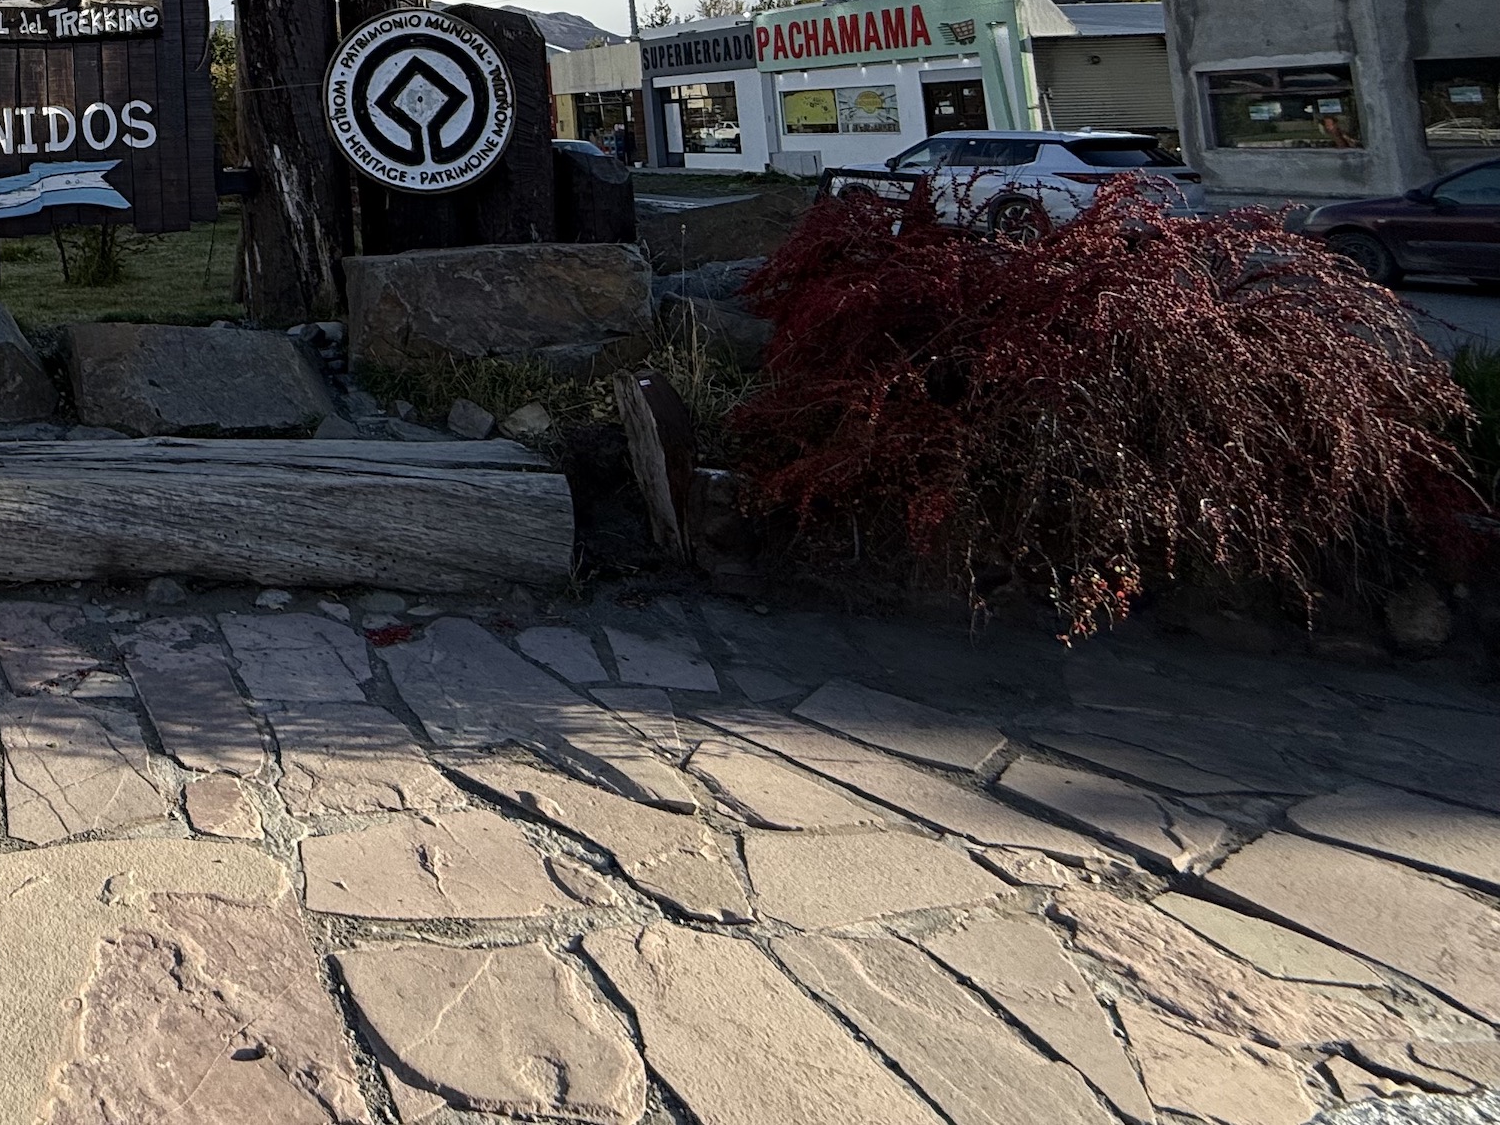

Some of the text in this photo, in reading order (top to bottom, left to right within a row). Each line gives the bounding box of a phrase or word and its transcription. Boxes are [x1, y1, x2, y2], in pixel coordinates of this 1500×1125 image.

[48, 6, 160, 38] TREKKING
[341, 14, 489, 69] PATRIMONIO MUNDIAL
[642, 4, 932, 70] SUPERMERCADO PACHAMAMA
[333, 80, 407, 183] WORLD HERITAGE
[419, 64, 508, 185] PATRIMOINE MONDIAL
